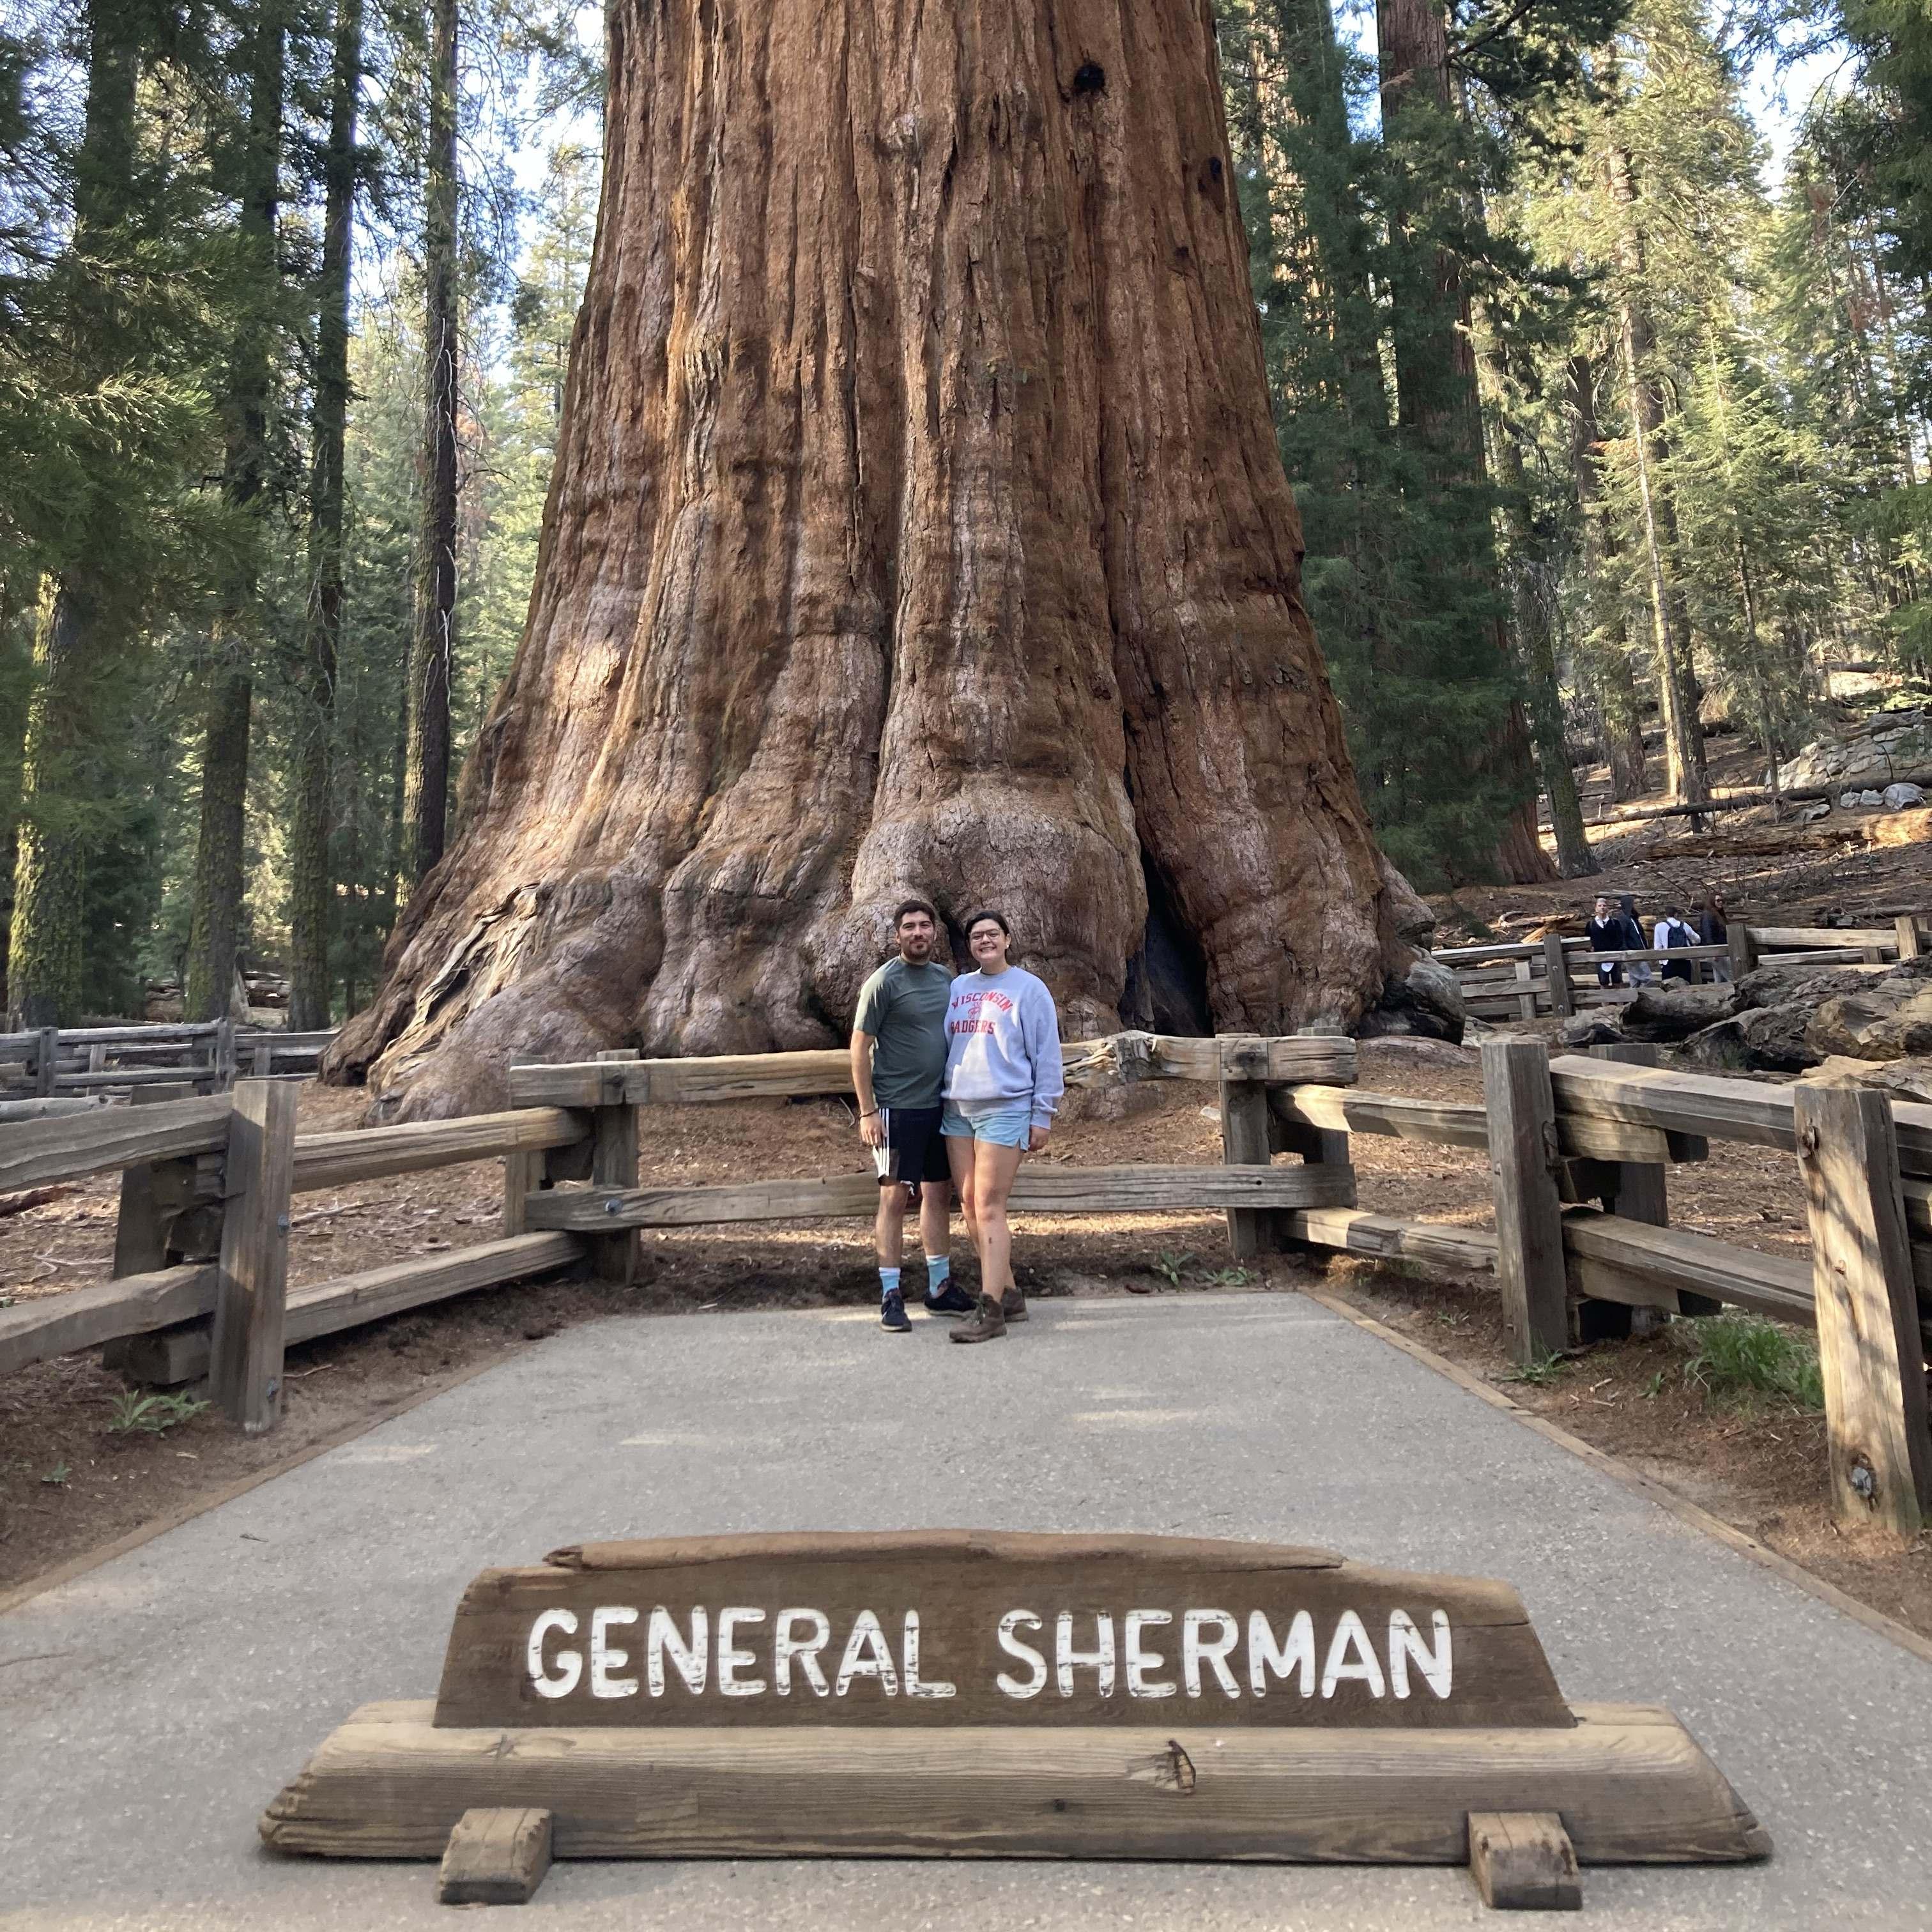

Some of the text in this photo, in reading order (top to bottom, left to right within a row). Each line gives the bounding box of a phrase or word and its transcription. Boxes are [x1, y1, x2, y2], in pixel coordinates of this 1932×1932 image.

[951, 992, 1013, 1012] WISCONSIN
[950, 1019, 995, 1034] BADGERS
[526, 1604, 1453, 1699] GENERAL SHERMAN
